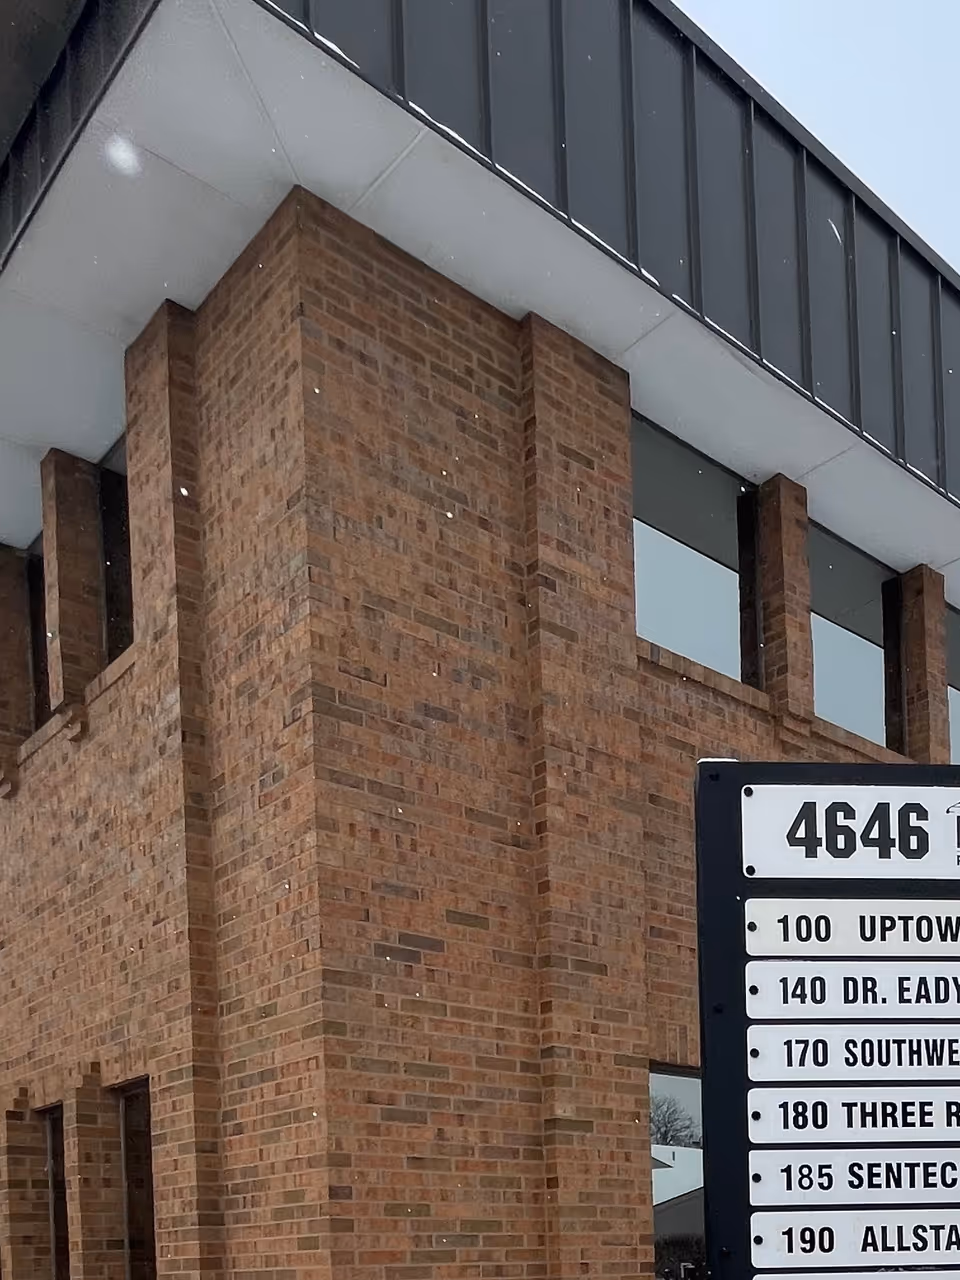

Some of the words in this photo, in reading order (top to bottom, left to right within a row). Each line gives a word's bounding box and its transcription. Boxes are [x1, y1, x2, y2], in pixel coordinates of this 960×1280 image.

[786, 802, 929, 859] 4646
[778, 915, 830, 942] 100
[780, 977, 825, 1004] 140
[844, 977, 886, 1004] DR.
[784, 1039, 828, 1067] 170
[779, 1101, 827, 1129] 180
[842, 1102, 933, 1128] THREE
[781, 1164, 833, 1190] 185
[782, 1227, 834, 1253] 190
